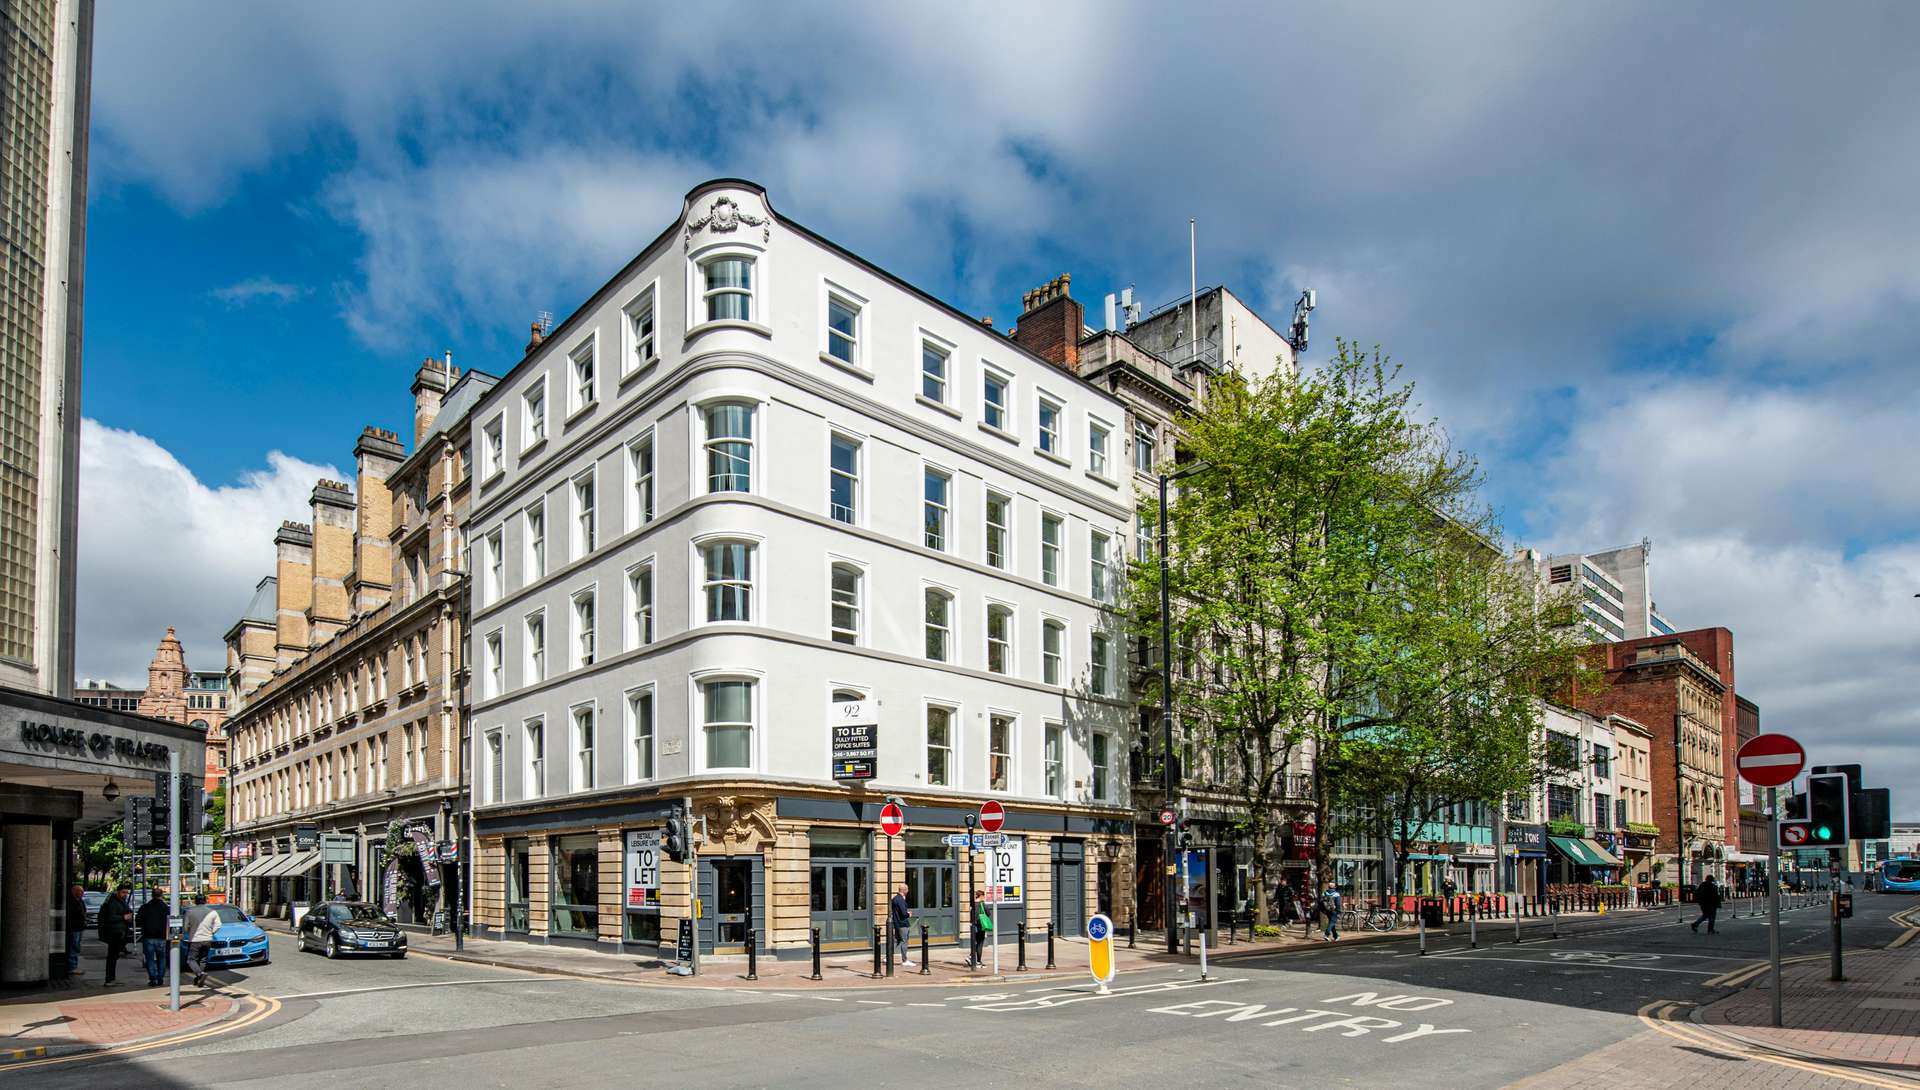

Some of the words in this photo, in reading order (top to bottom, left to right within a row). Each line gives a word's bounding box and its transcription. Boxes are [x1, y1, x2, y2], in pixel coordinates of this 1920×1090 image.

[844, 705, 860, 718] 92
[837, 728, 849, 736] TO
[851, 727, 868, 735] LET
[20, 720, 85, 748] HOUSE
[88, 732, 113, 752] OF
[114, 736, 169, 762] FRASER
[637, 849, 653, 867] TO
[996, 852, 1011, 867] TO
[634, 868, 656, 884] LET
[996, 868, 1014, 882] ET
[1320, 992, 1453, 1010] NO
[1145, 1000, 1472, 1043] ENTRY
